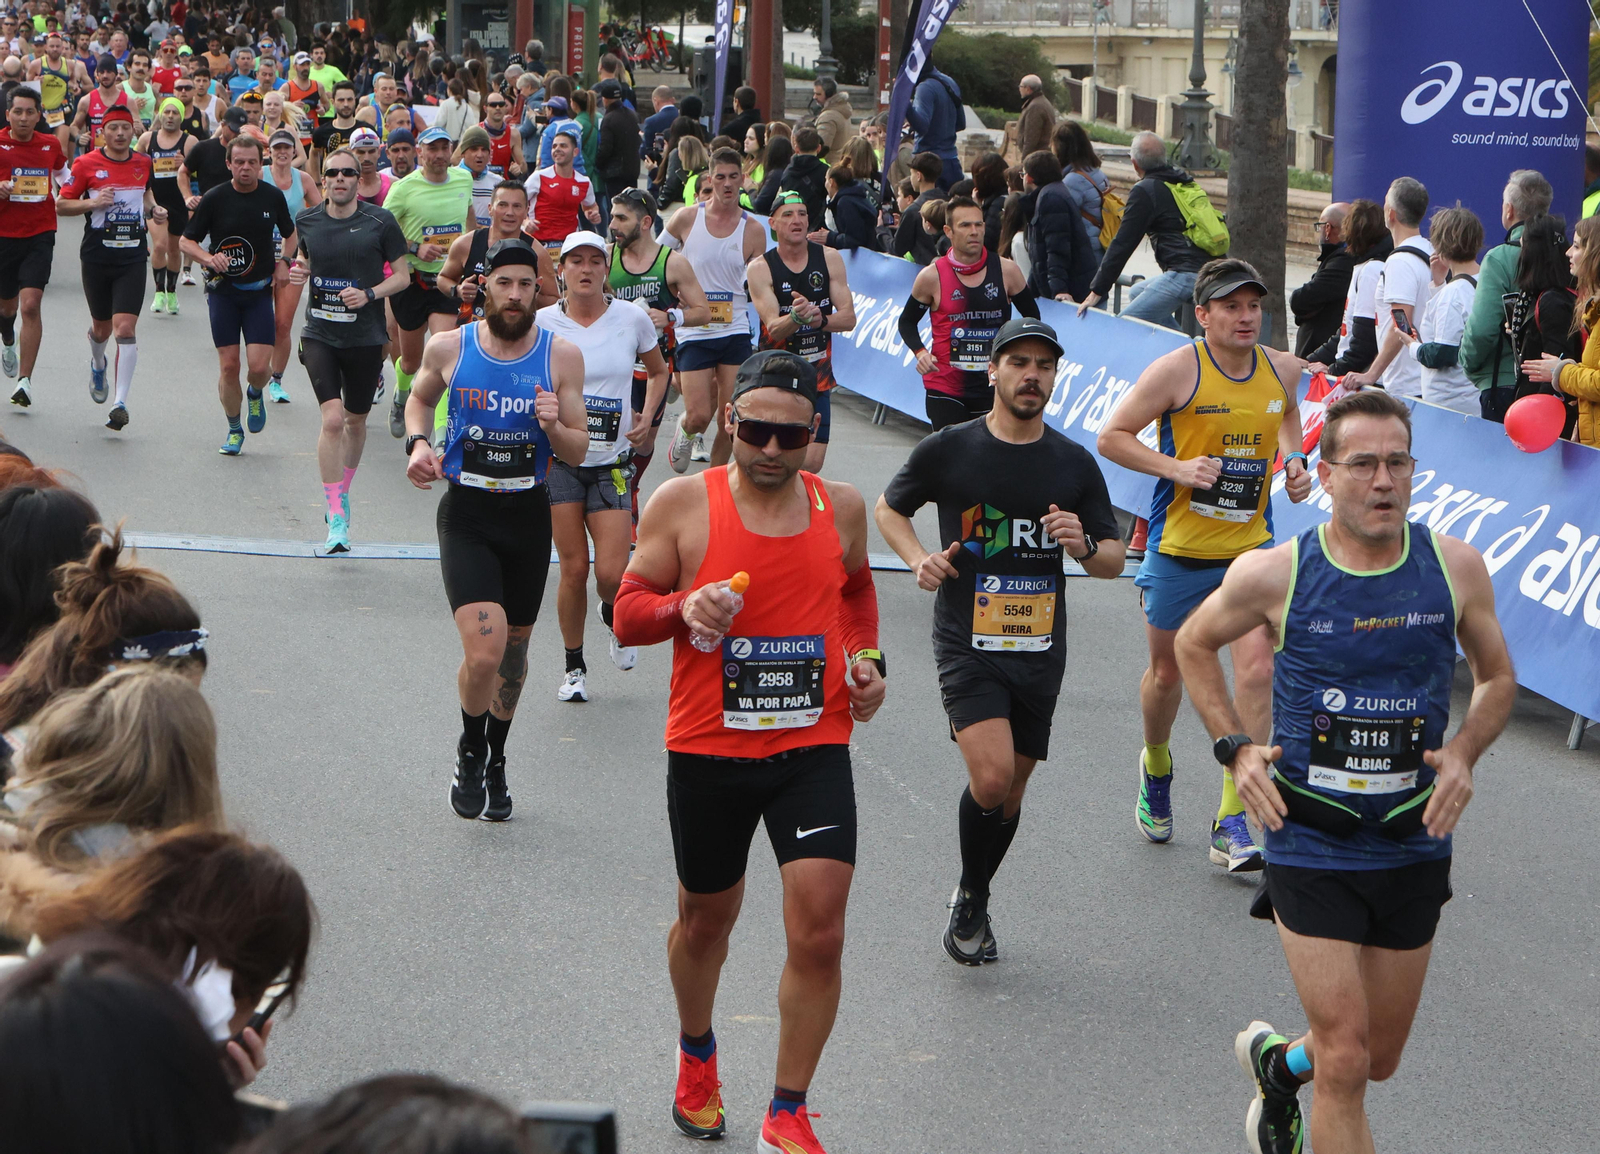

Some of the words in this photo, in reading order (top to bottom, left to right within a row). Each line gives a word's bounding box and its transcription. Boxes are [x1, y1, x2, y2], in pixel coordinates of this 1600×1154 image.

[574, 27, 583, 60] PASEO
[1462, 76, 1571, 119] asics
[1452, 132, 1494, 145] sound
[1497, 131, 1529, 147] mind,
[1532, 132, 1561, 147] sound
[1563, 134, 1580, 150] body
[24, 168, 45, 176] ZURICH
[117, 225, 131, 233] 2233
[436, 226, 458, 234] ZURICH
[222, 247, 244, 258] RUN
[324, 279, 352, 287] ZURICH
[616, 281, 661, 300] MOJAMAS
[801, 336, 816, 345] 3107
[966, 343, 983, 352] 3151
[958, 354, 972, 362] WAN
[456, 387, 537, 418] TRISpor
[585, 398, 617, 409] ZURICH
[1195, 407, 1231, 415] RUNNERS
[586, 416, 603, 427] 908
[488, 431, 529, 441] ZURICH
[588, 431, 607, 440] ABEE
[1222, 433, 1263, 446] CHILE
[486, 450, 512, 463] 3489
[1223, 447, 1256, 457] SPARTA
[1226, 461, 1262, 473] ZURICH
[1220, 480, 1245, 494] 3239
[1006, 579, 1048, 591] ZURICH
[1003, 604, 1033, 617] 5549
[1001, 624, 1033, 635] VIEIRA
[759, 641, 815, 654] ZURICH
[758, 671, 794, 687] 2958
[738, 697, 754, 709] VA
[756, 697, 780, 709] POR
[783, 691, 812, 709] PAPÁ
[1353, 696, 1417, 711] ZURICH
[1349, 729, 1390, 747] 3118
[1345, 756, 1392, 771] ALBIAC
